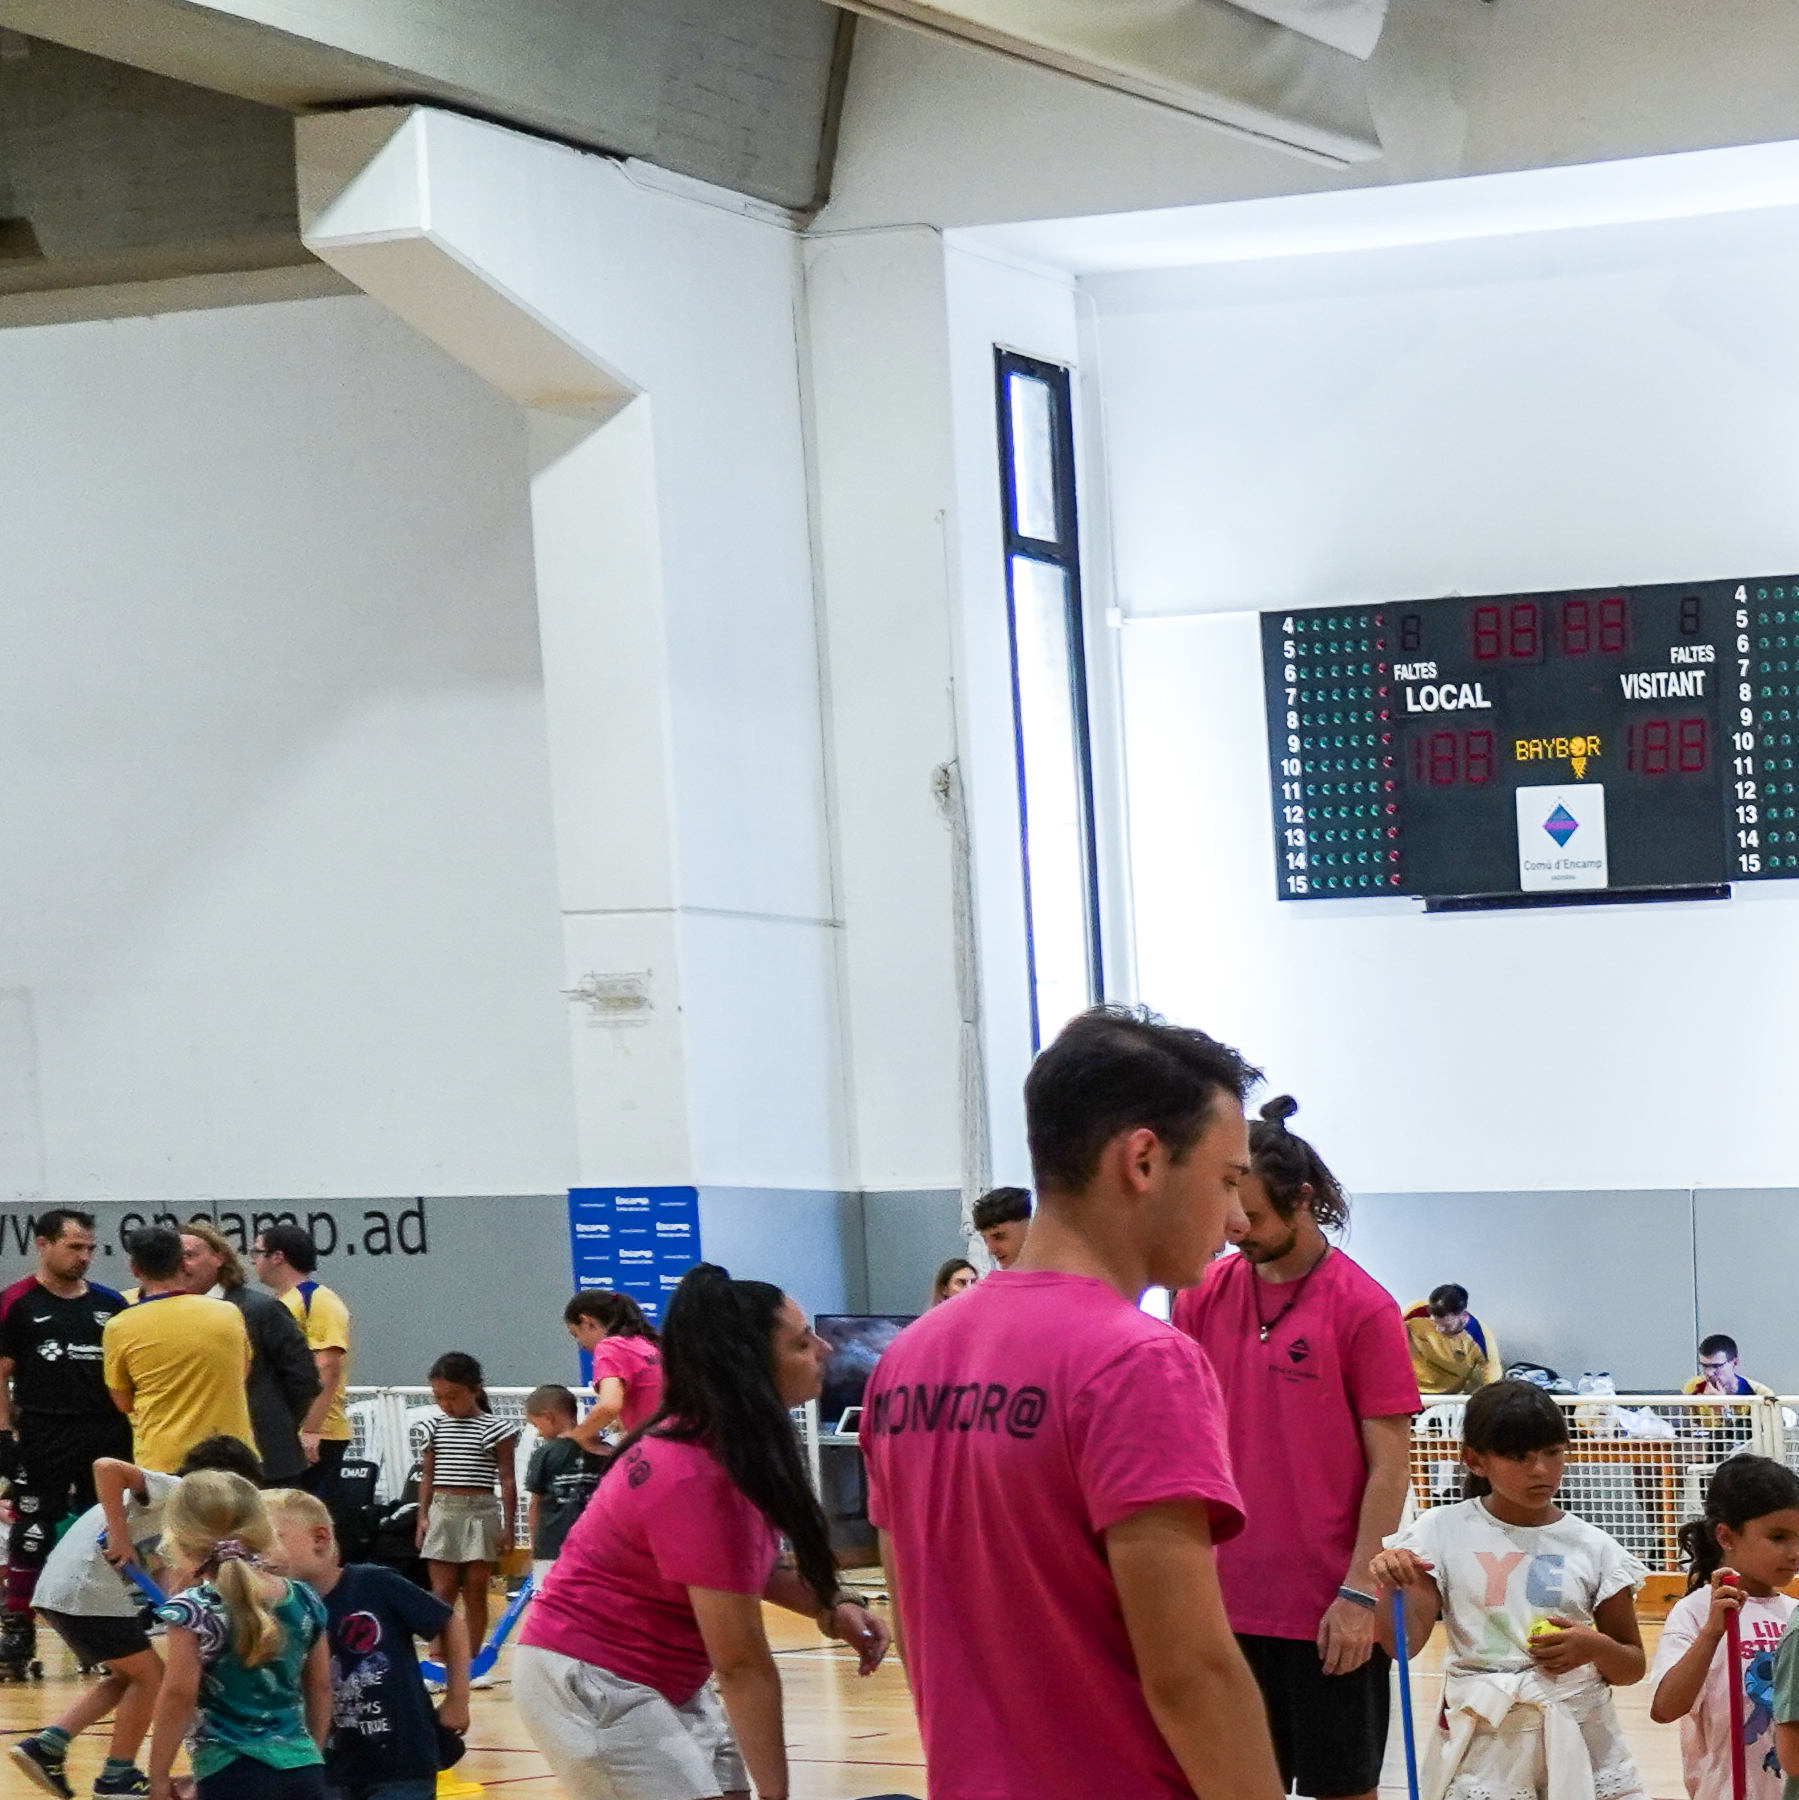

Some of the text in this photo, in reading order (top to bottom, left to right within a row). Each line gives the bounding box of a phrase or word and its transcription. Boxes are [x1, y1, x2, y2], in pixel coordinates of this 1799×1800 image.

[1735, 585, 1747, 603] 4
[1282, 617, 1294, 634] 4
[1736, 610, 1748, 628] 5
[1283, 641, 1296, 658] 5
[1737, 634, 1749, 652] 6
[1670, 644, 1716, 664] FALTES
[1284, 664, 1297, 681] 6
[1394, 661, 1438, 681] FALTES
[1738, 659, 1750, 677] 7
[1619, 669, 1707, 700] VISITANT
[1739, 683, 1751, 701] 8
[1285, 688, 1297, 705] 7
[1405, 682, 1492, 713] LOCAL
[1286, 712, 1299, 729] 8
[1740, 708, 1752, 726] 9
[1287, 735, 1300, 752] 9
[1732, 732, 1754, 750] 10
[1281, 759, 1301, 776] 10
[1733, 757, 1753, 775] 11
[1281, 783, 1301, 799] 11
[1735, 782, 1757, 799] 12
[1283, 806, 1304, 823] 12
[1736, 806, 1758, 824] 13
[1284, 829, 1306, 846] 13
[1737, 830, 1759, 848] 14
[1286, 852, 1307, 870] 14
[1739, 854, 1760, 872] 15
[1287, 876, 1308, 894] 15
